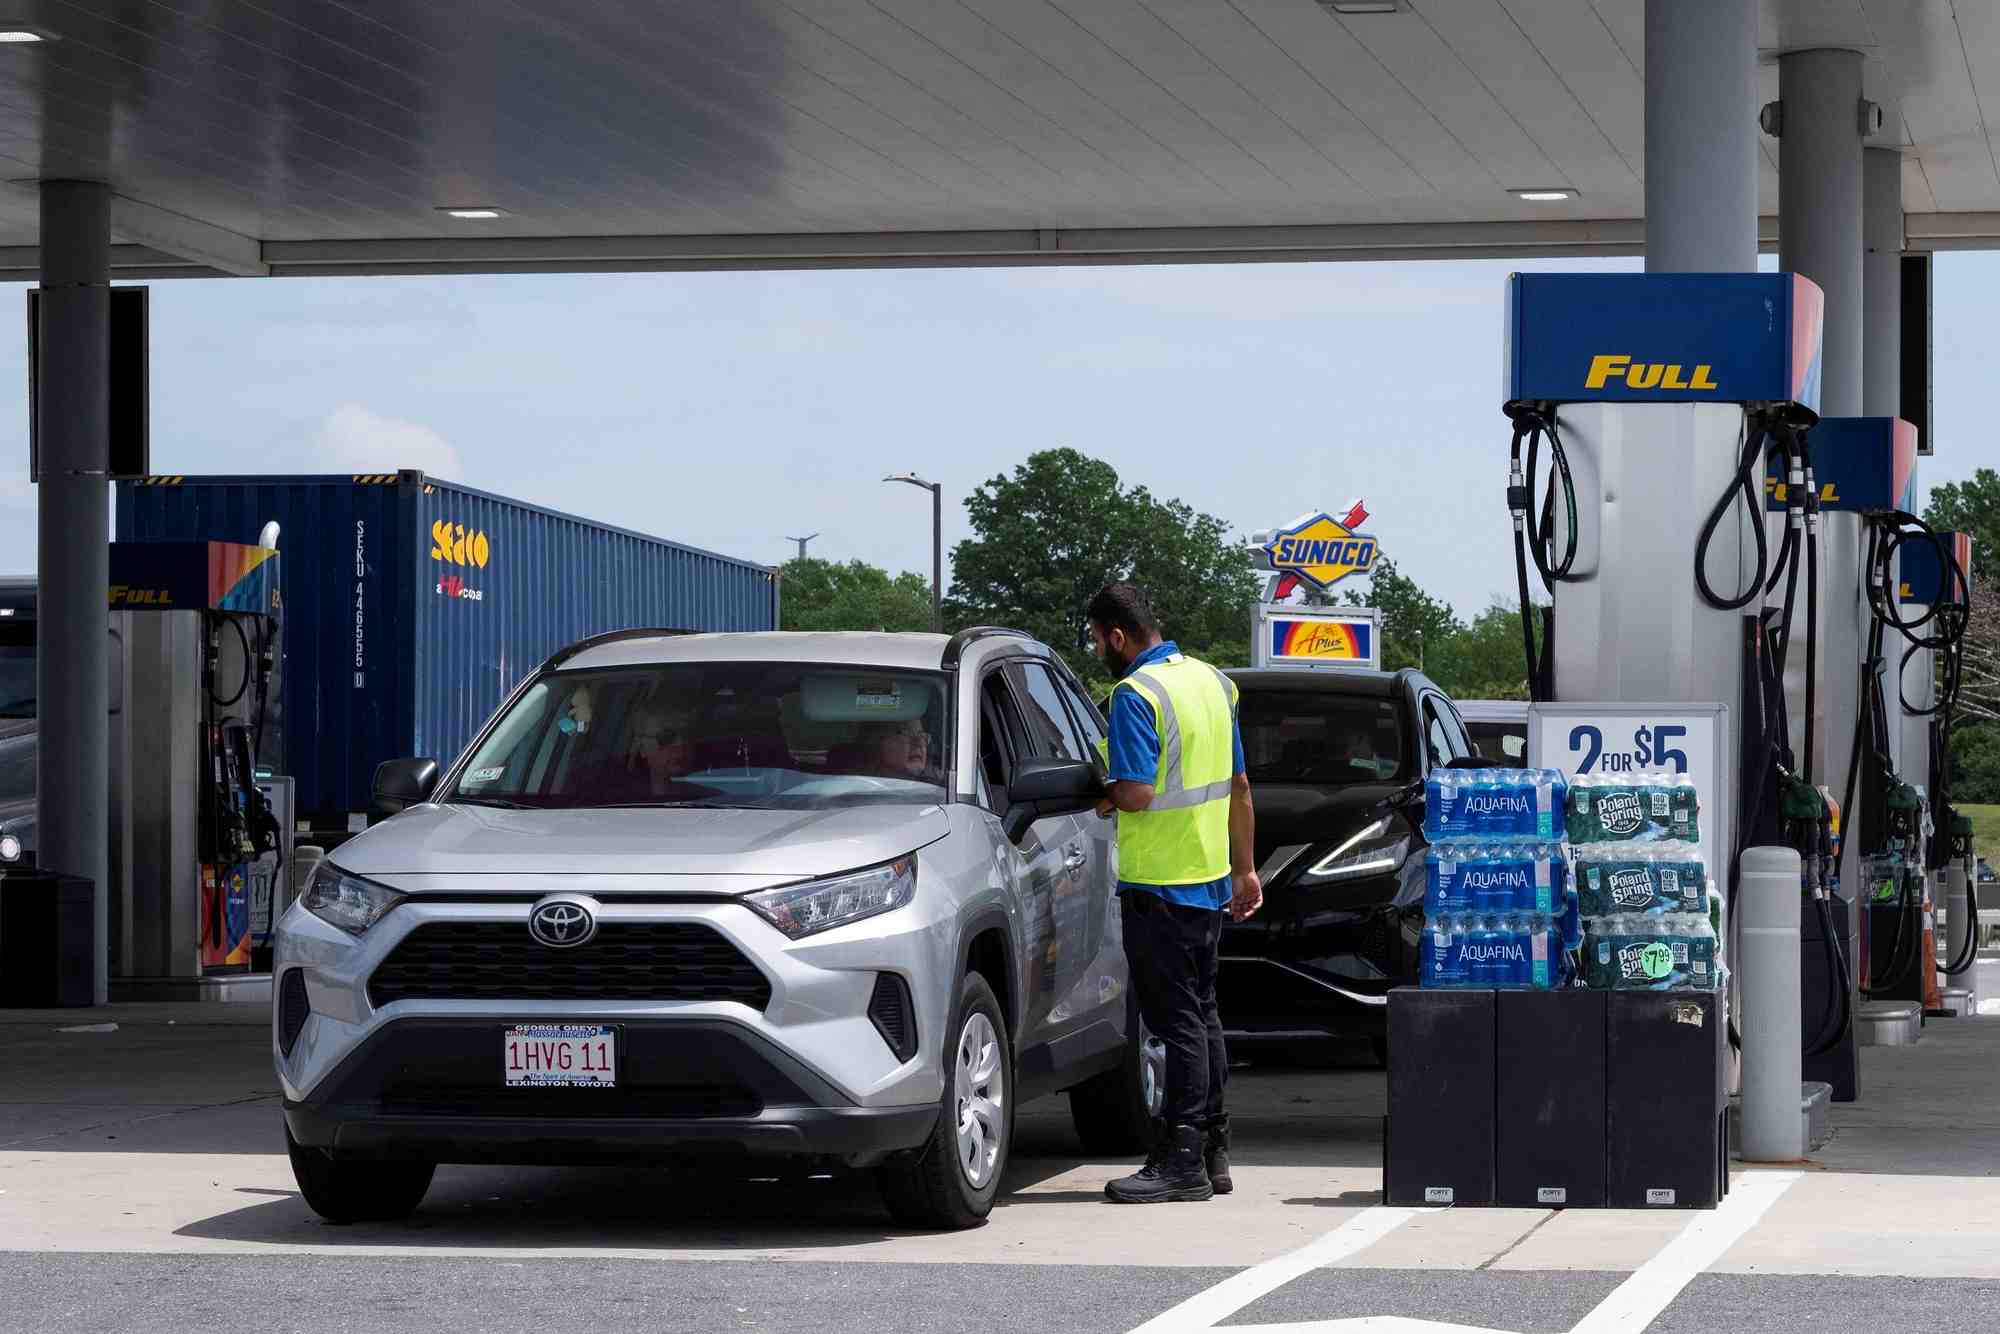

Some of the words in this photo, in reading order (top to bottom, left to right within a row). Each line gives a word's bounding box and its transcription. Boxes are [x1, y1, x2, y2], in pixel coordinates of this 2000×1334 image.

[1585, 355, 1718, 390] FULL
[356, 520, 365, 577] SEKU
[1277, 539, 1374, 567] SUNOCO
[1569, 725, 1603, 774] 2
[1602, 753, 1632, 771] FOR
[1464, 795, 1530, 815] AQUAFINA
[1597, 791, 1641, 814] Poland
[1599, 805, 1643, 829] Spring
[1462, 870, 1528, 889] AQUAFINA
[1608, 867, 1651, 891] Poland
[1611, 882, 1654, 904] Spring
[1459, 943, 1526, 962] AQUAFINA
[509, 1041, 572, 1070] 1HVG
[581, 1042, 611, 1071] 11
[572, 1080, 615, 1088] TOYOTA
